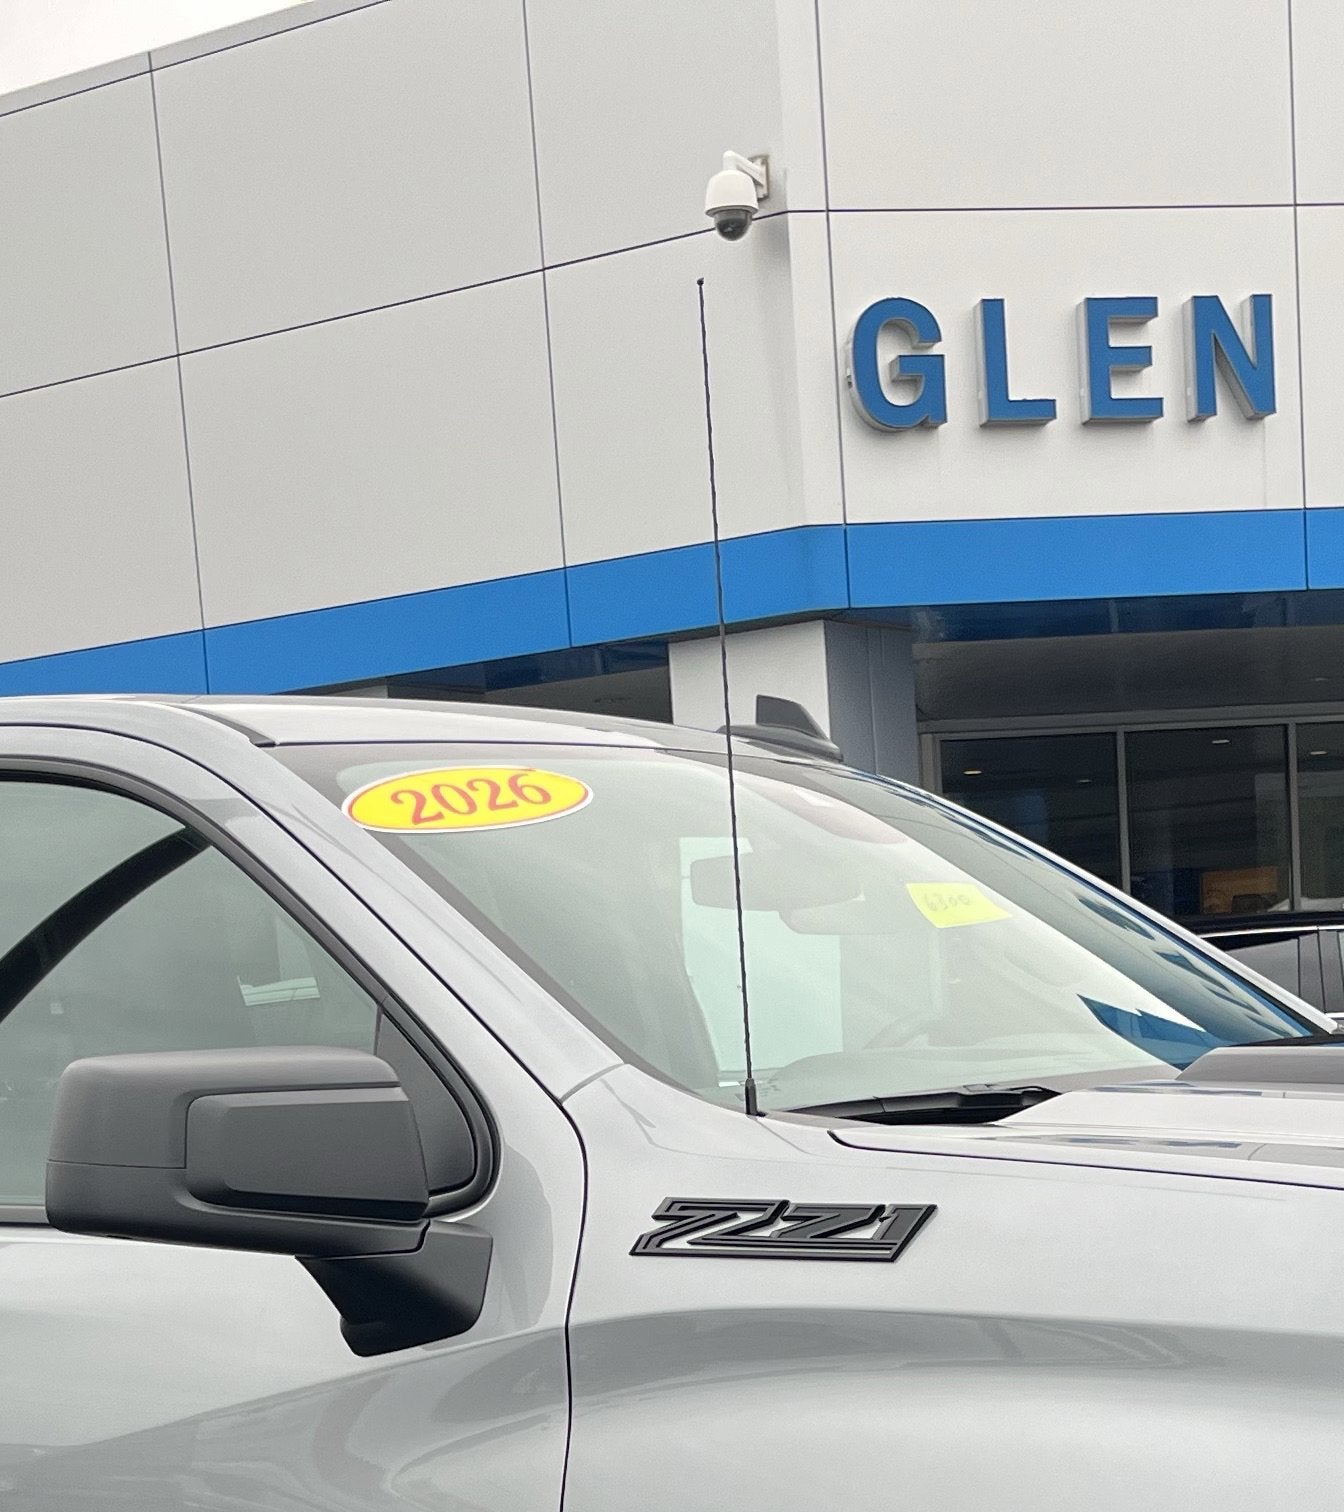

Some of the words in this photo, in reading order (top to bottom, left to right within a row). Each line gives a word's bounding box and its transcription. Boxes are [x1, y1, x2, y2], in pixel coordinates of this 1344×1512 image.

[847, 294, 1277, 432] GLEN
[390, 773, 552, 826] 2026
[629, 1197, 938, 1262] Z71
